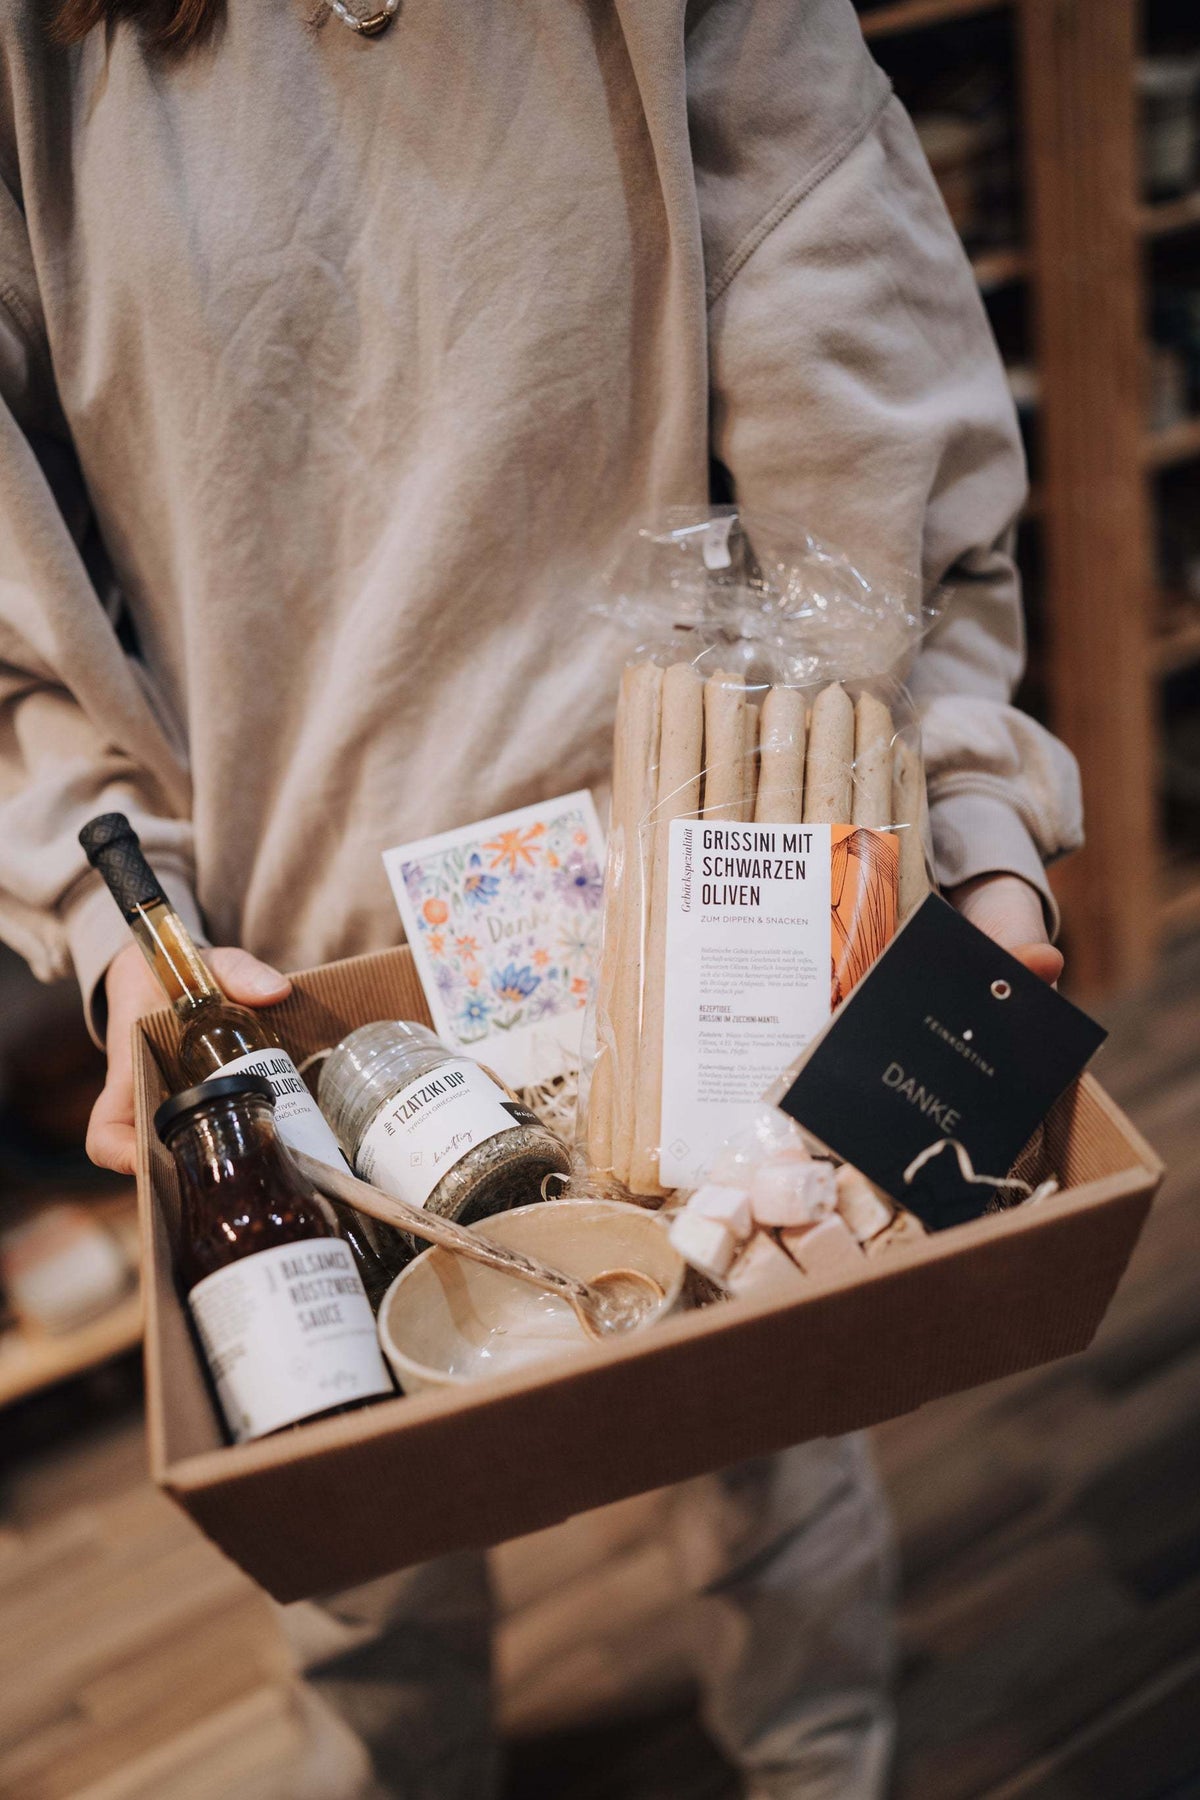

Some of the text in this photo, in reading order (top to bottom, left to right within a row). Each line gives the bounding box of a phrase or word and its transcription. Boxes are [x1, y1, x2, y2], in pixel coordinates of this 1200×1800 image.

[703, 829, 813, 853] GRISSINI MIT
[681, 828, 694, 913] Gebäckspezialität
[702, 856, 806, 880] SCHWARZEN
[702, 884, 761, 906] OLIVEN
[700, 915, 809, 926] ZUM DIPPEN & SNACKEN
[391, 1071, 466, 1126] TZATZIKI DIP
[406, 1088, 472, 1135] TYPISCH GRIECHISCH
[881, 1061, 962, 1134] DANKE
[298, 1302, 345, 1332] SAUCE
